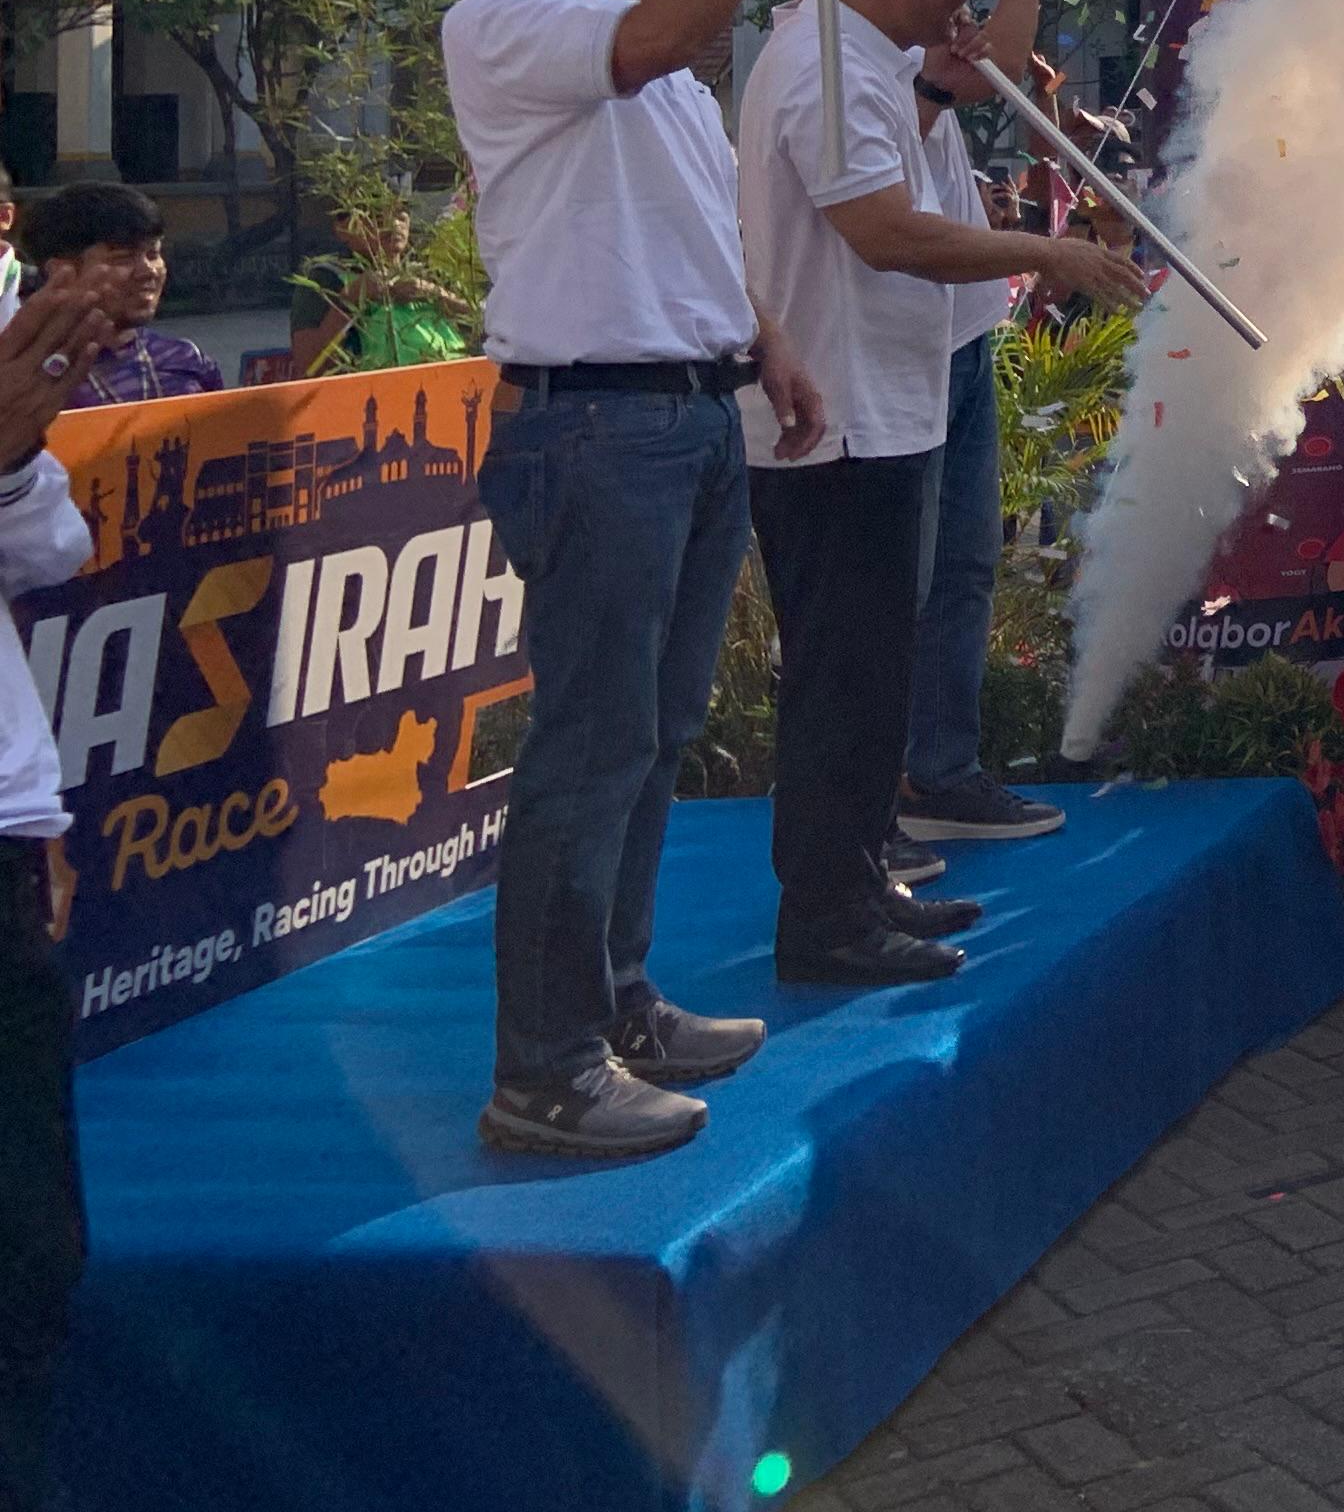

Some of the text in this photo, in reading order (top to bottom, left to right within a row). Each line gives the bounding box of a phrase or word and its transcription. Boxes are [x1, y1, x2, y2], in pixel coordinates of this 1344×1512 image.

[103, 777, 299, 891] Race
[81, 927, 243, 1019] Heritage,
[253, 877, 357, 948] Racing
[363, 822, 476, 900] Through
